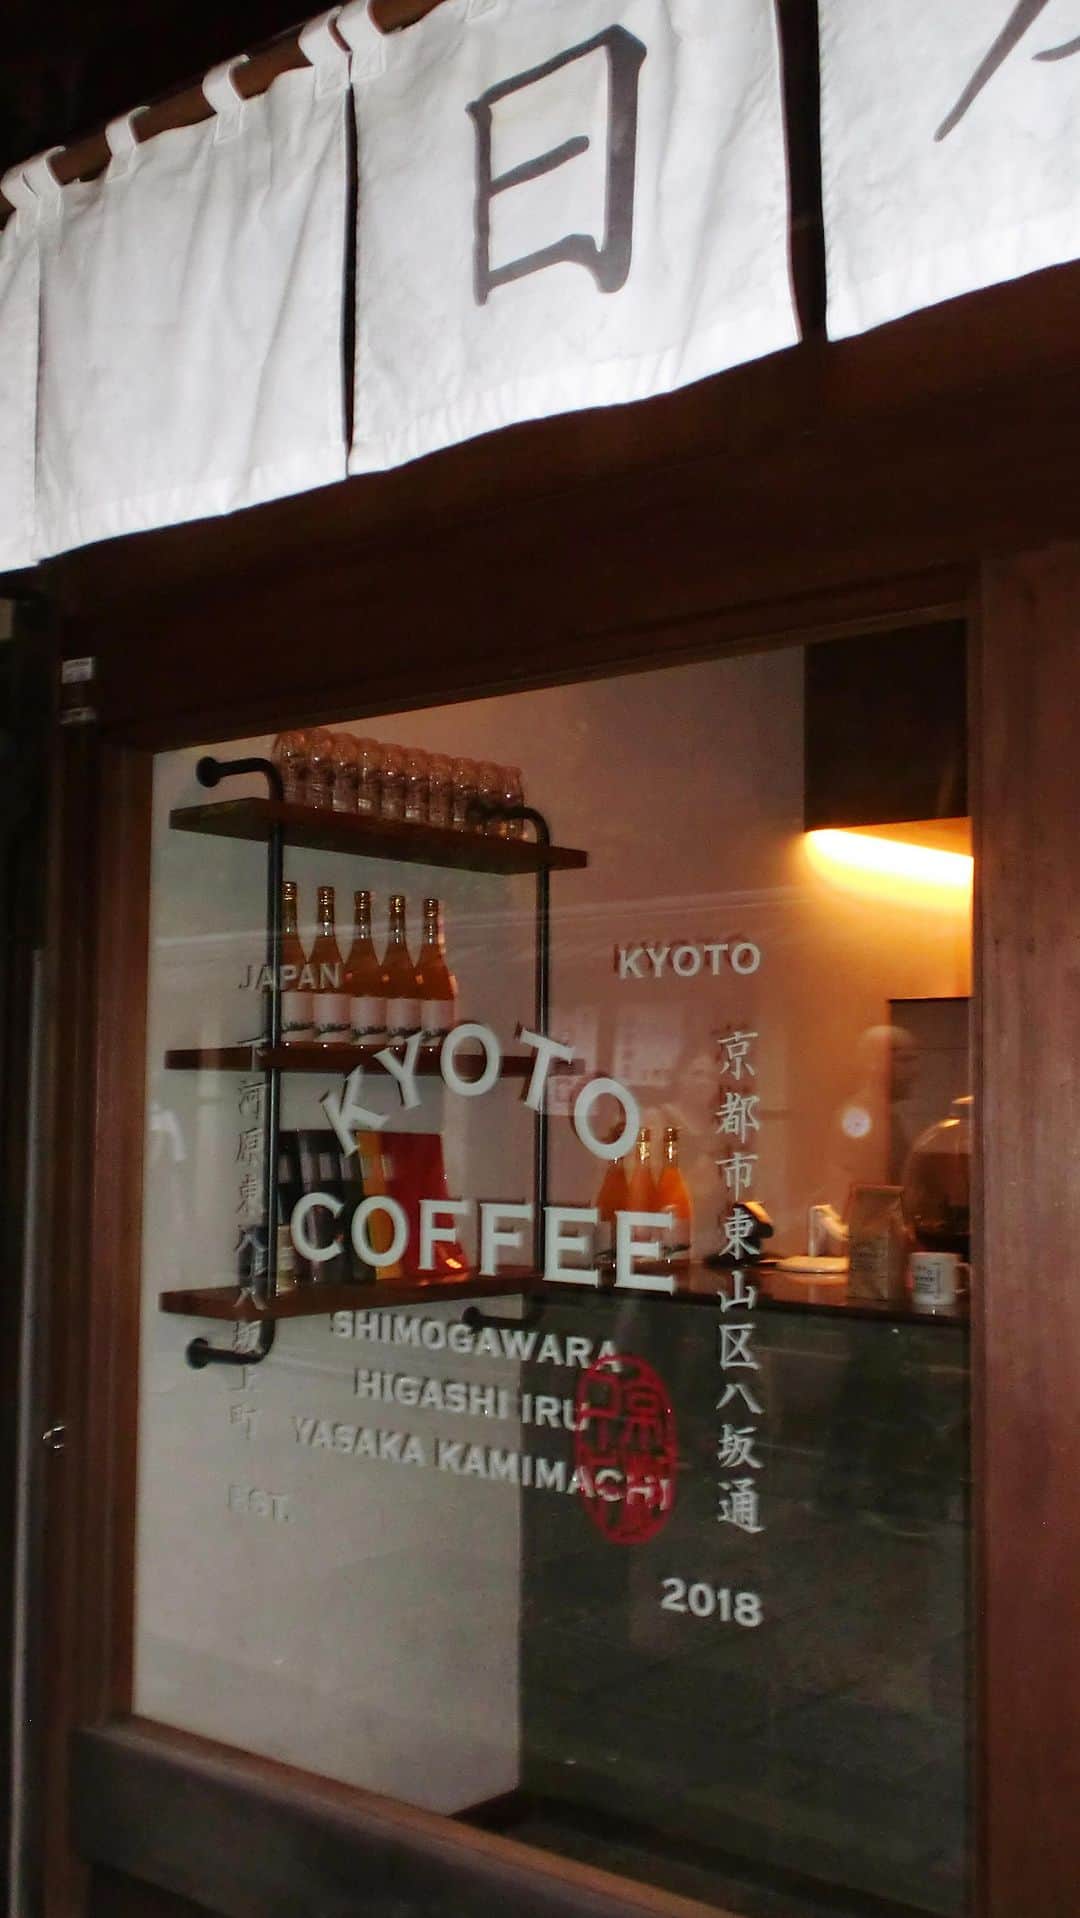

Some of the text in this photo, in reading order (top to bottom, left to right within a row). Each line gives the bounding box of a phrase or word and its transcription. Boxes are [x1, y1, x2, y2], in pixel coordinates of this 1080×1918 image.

[466, 24, 648, 306] 日
[238, 963, 342, 991] JAPAN
[617, 942, 761, 980] KYOTO
[322, 1023, 641, 1161] KYOTO
[291, 1192, 675, 1295] COFFEE
[714, 1029, 766, 1534] 京都市東山区八坂通
[332, 1310, 623, 1373] SHIMOGAWARA
[355, 1369, 592, 1432] HIGASHI IRU
[295, 1416, 672, 1510] YASAKA KAMIMACHI
[660, 1577, 764, 1629] 2018
